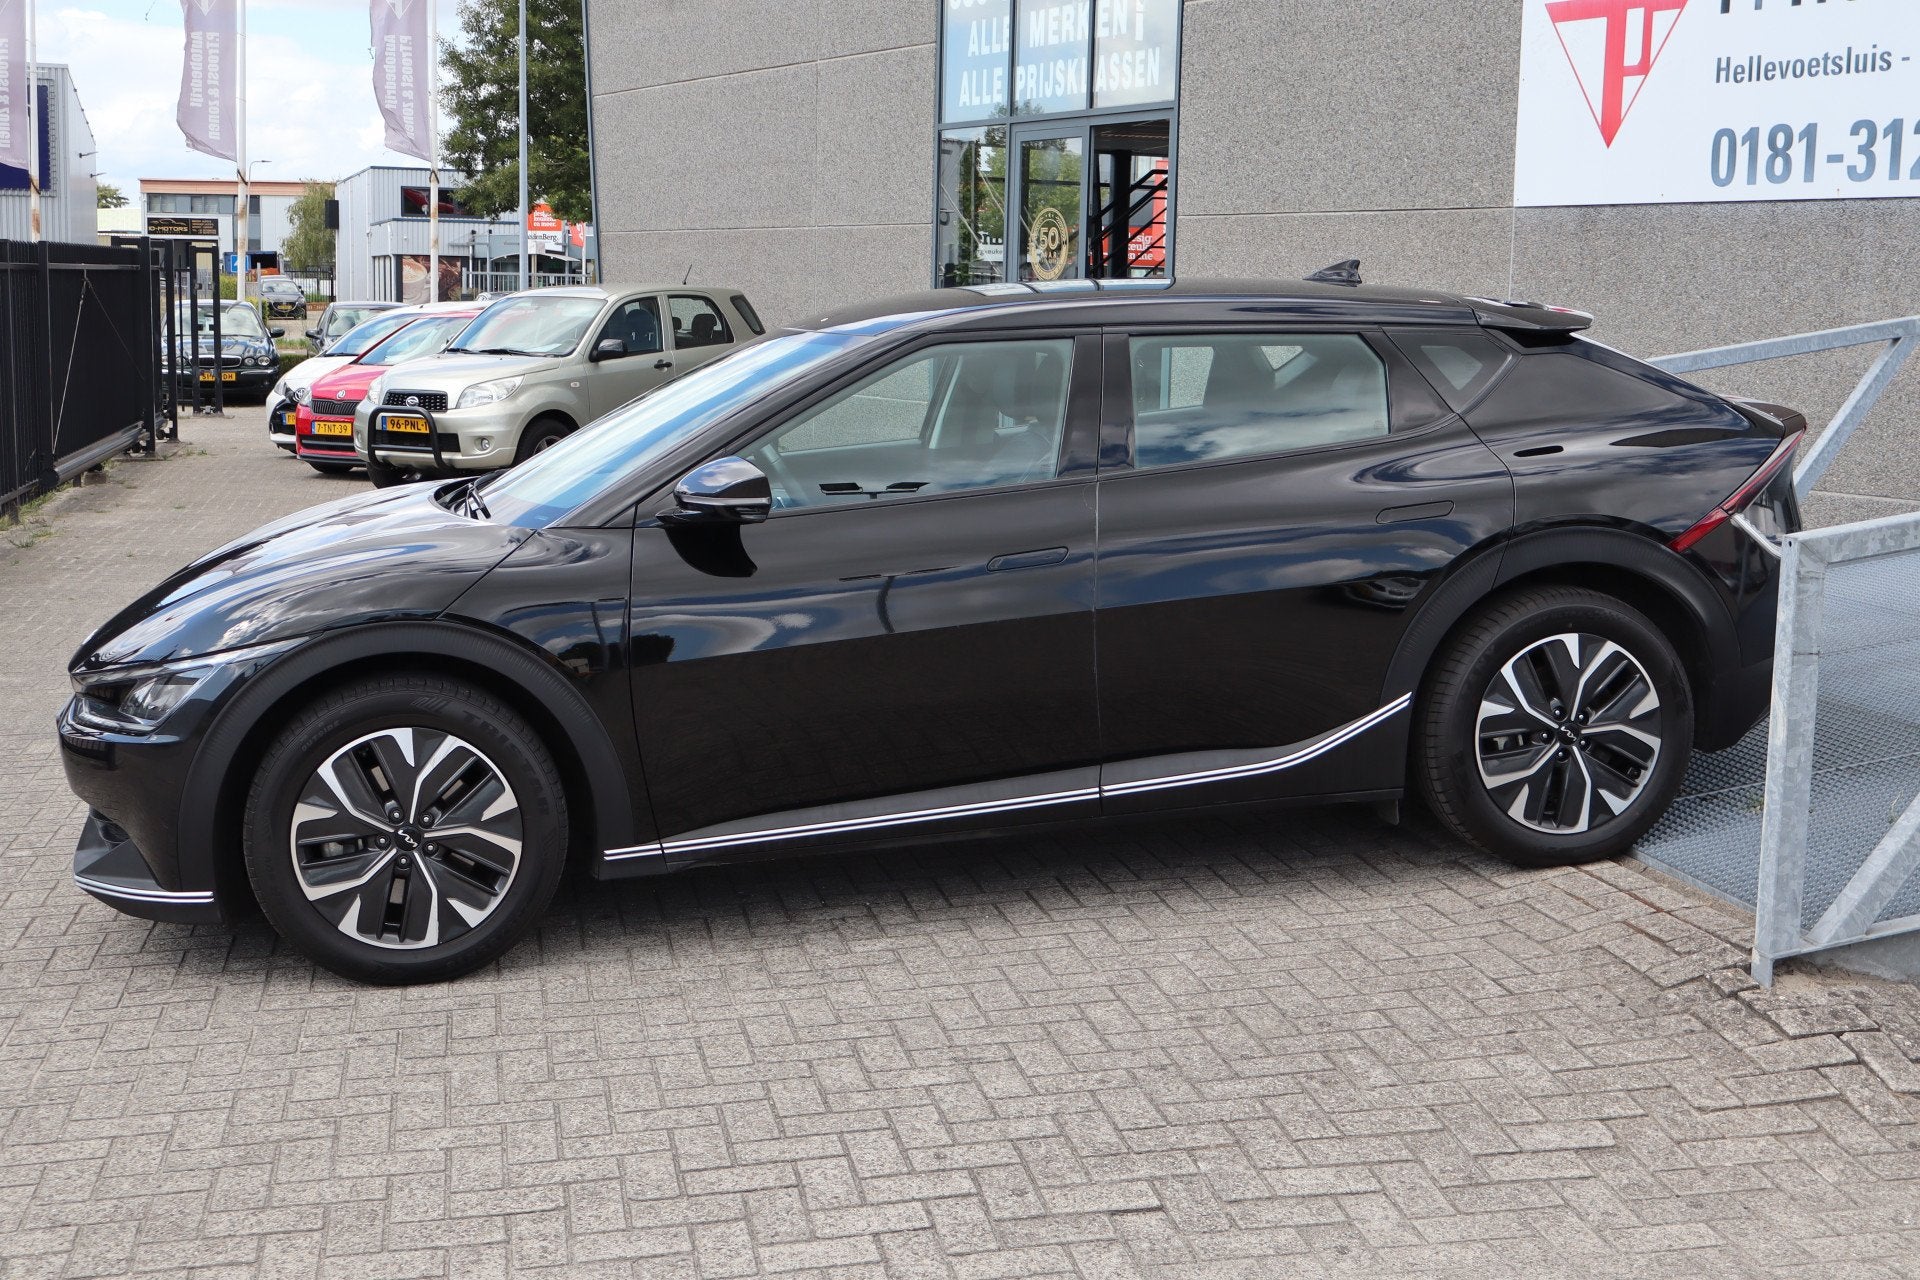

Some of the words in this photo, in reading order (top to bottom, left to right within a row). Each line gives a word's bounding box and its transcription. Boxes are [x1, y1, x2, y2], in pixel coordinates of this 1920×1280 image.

[967, 15, 1009, 57] ALLE
[1028, 0, 1128, 49] MERKEN
[959, 67, 1003, 107] ALLE
[1016, 46, 1161, 100] PRIJSKLASSEN
[1715, 44, 1892, 84] Hellevoetsluis
[1039, 226, 1060, 250] 50
[317, 423, 348, 433] 7-TNT-39
